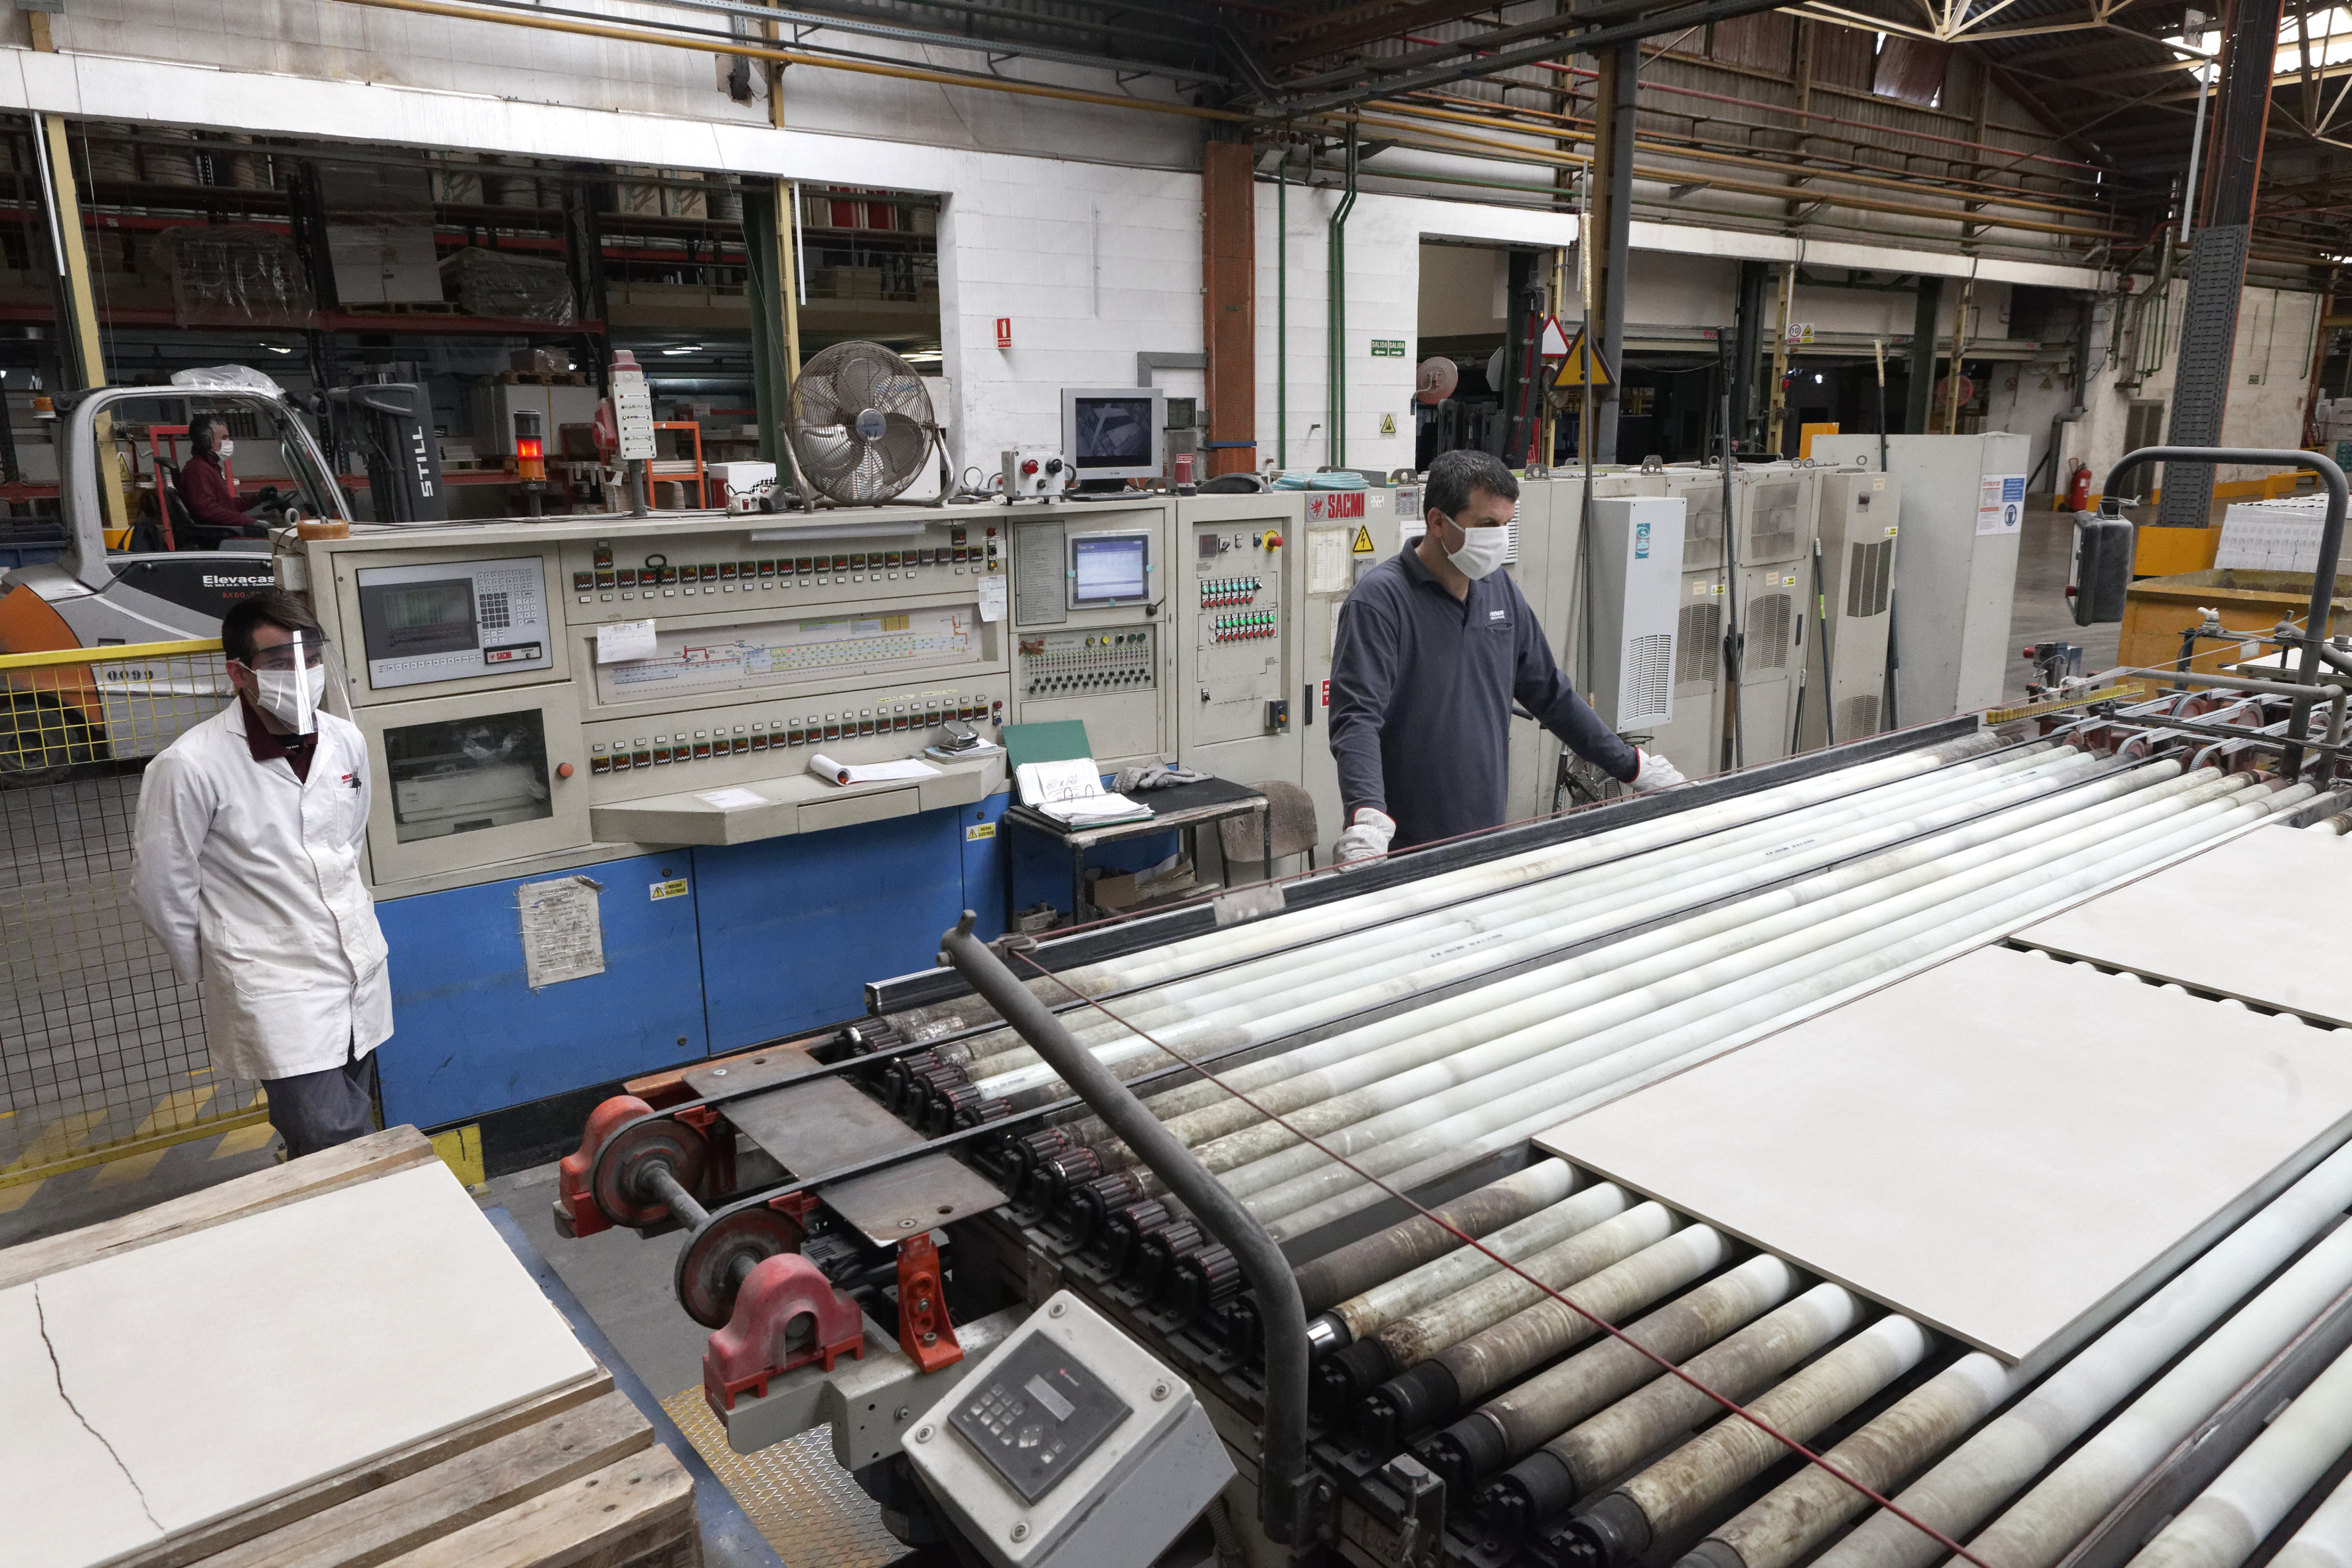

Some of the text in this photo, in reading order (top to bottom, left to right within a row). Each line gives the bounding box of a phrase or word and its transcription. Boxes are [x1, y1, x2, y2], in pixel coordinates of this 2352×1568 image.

[412, 426, 433, 497] STILL
[1328, 493, 1364, 518] SACMI
[497, 651, 512, 660] SACMI
